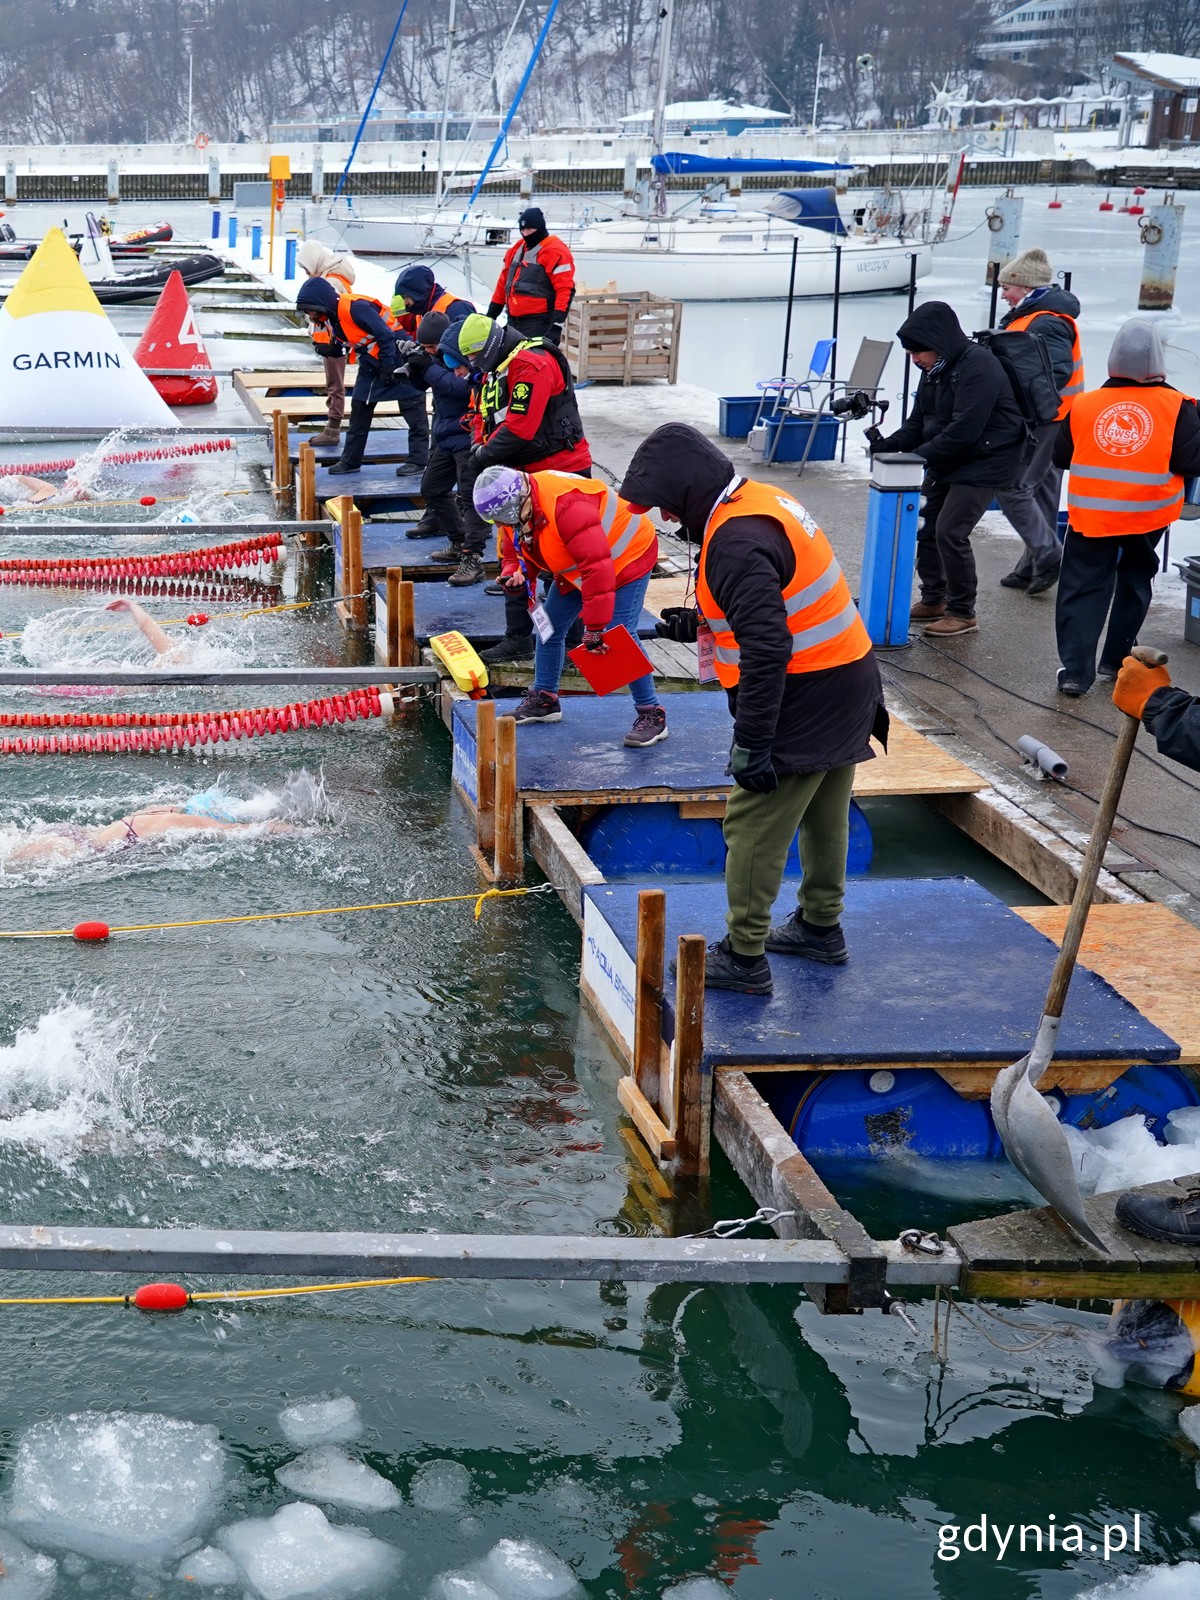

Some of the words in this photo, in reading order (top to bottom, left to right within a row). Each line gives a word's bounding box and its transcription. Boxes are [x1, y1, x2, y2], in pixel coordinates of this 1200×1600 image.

[178, 304, 205, 353] 4
[12, 350, 121, 371] GARMIN
[1107, 428, 1138, 440] GWSC
[614, 973, 636, 1016] SPEE
